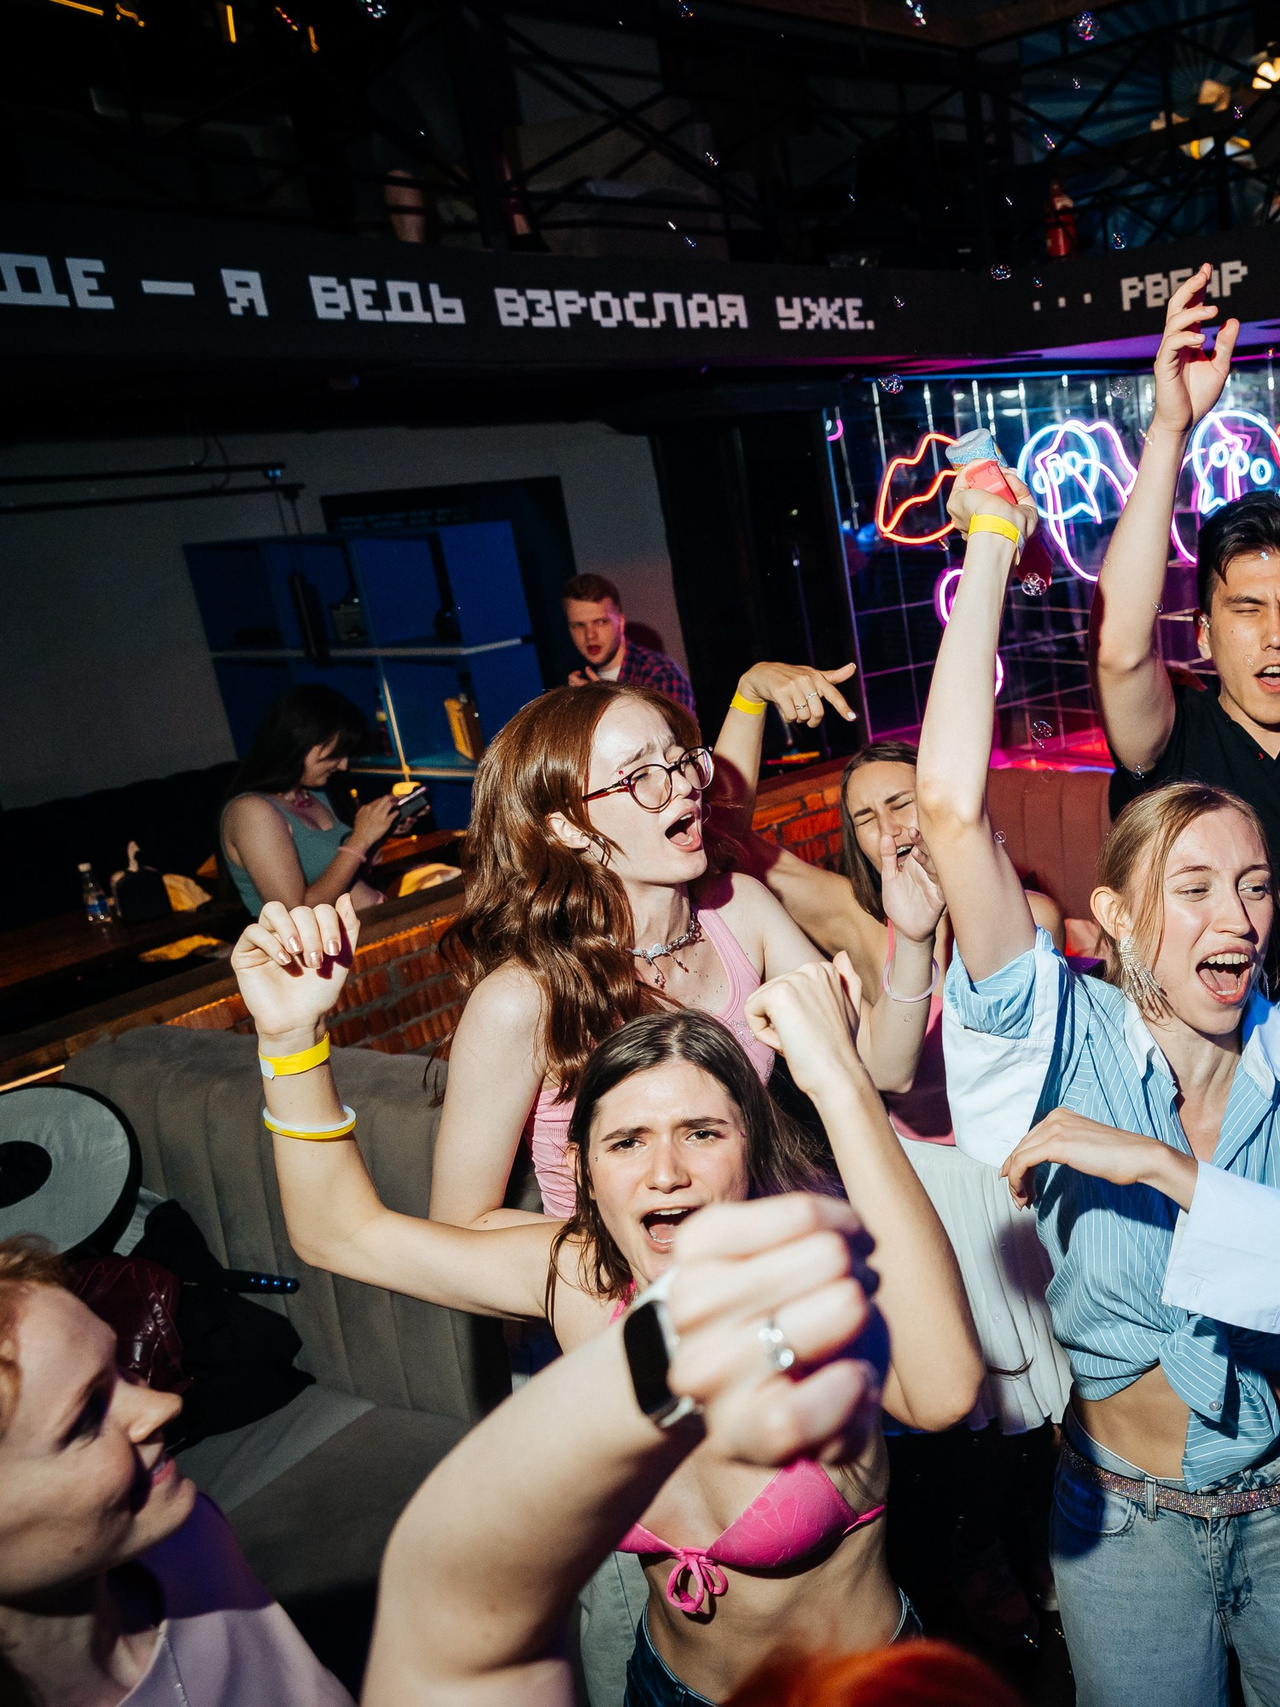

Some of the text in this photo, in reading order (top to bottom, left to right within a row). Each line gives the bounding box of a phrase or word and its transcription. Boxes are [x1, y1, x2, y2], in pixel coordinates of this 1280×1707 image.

[220, 268, 269, 317] Я
[308, 275, 466, 324] ВЕДЬ
[493, 287, 749, 329] ВЗРОСЛАЯ
[774, 295, 875, 331] УЖЕ.
